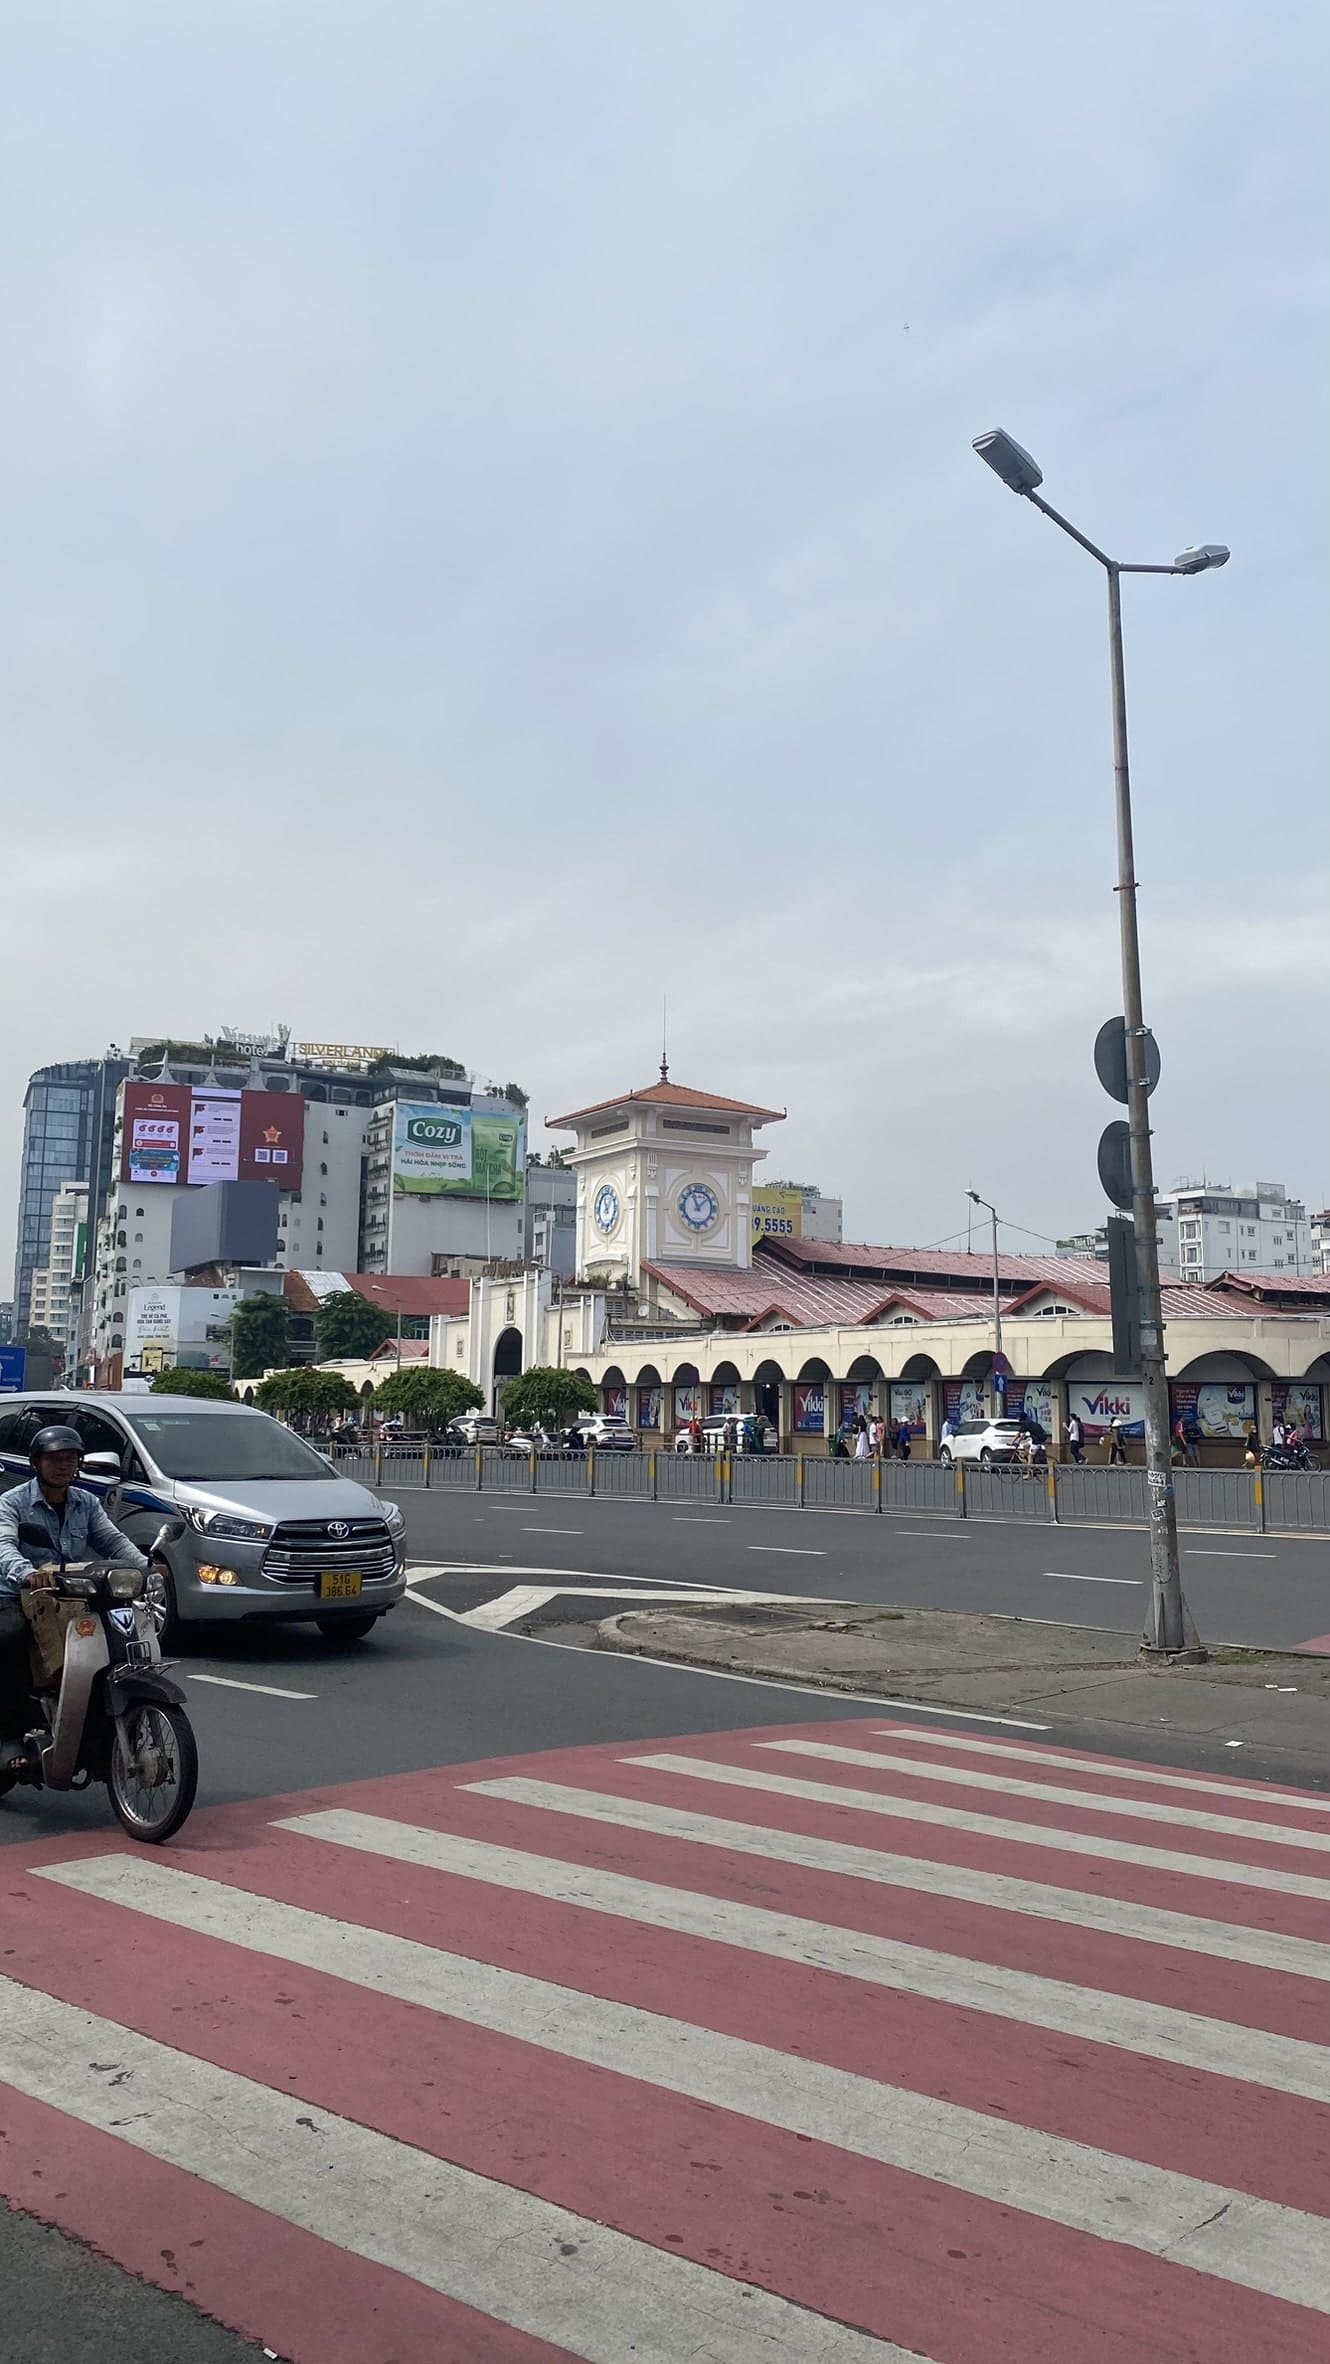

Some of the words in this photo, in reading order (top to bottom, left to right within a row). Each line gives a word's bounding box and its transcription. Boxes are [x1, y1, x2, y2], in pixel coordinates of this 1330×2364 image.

[299, 1043, 385, 1058] SILVERLAND
[412, 1121, 457, 1144] Cozy
[752, 1217, 793, 1233] 9.5555
[1081, 1388, 1131, 1416] Vikki
